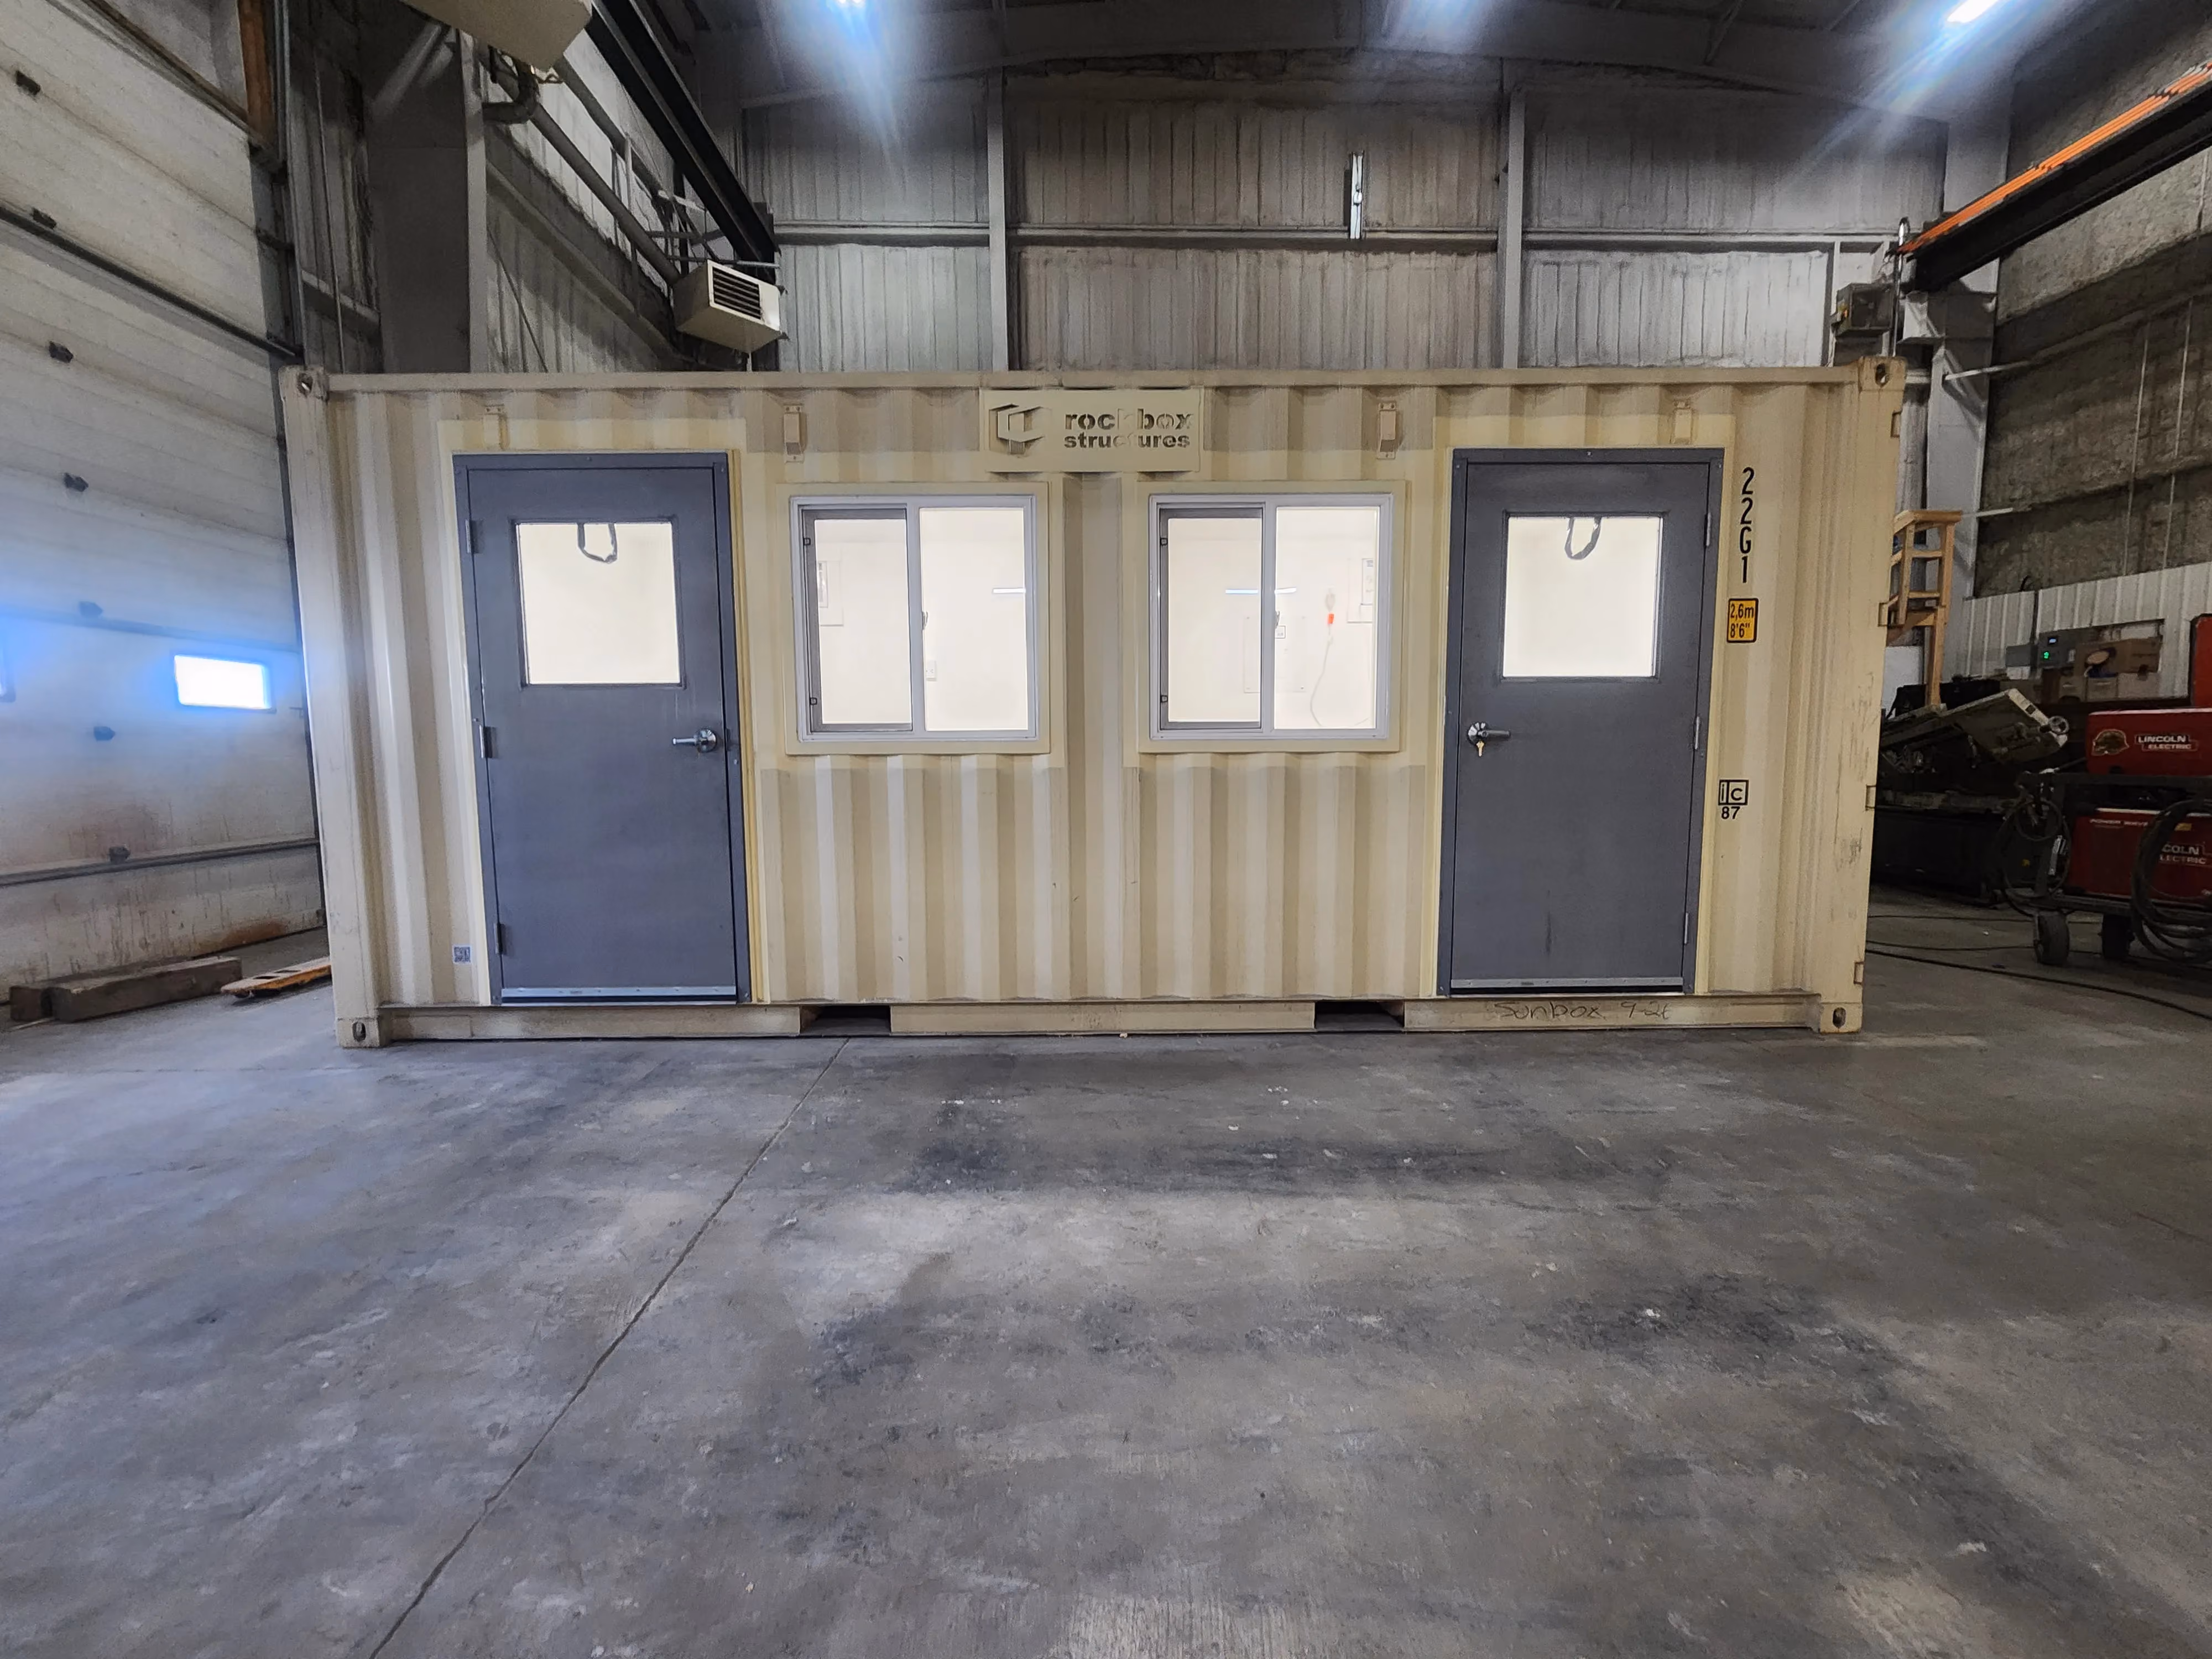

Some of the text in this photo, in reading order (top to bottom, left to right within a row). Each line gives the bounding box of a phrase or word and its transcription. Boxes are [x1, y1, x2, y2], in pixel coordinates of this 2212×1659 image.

[1739, 467, 1755, 583] 22G1
[1721, 806, 1740, 820] 87
[2161, 844, 2199, 855] COLN
[2159, 854, 2206, 864] LECTRIC
